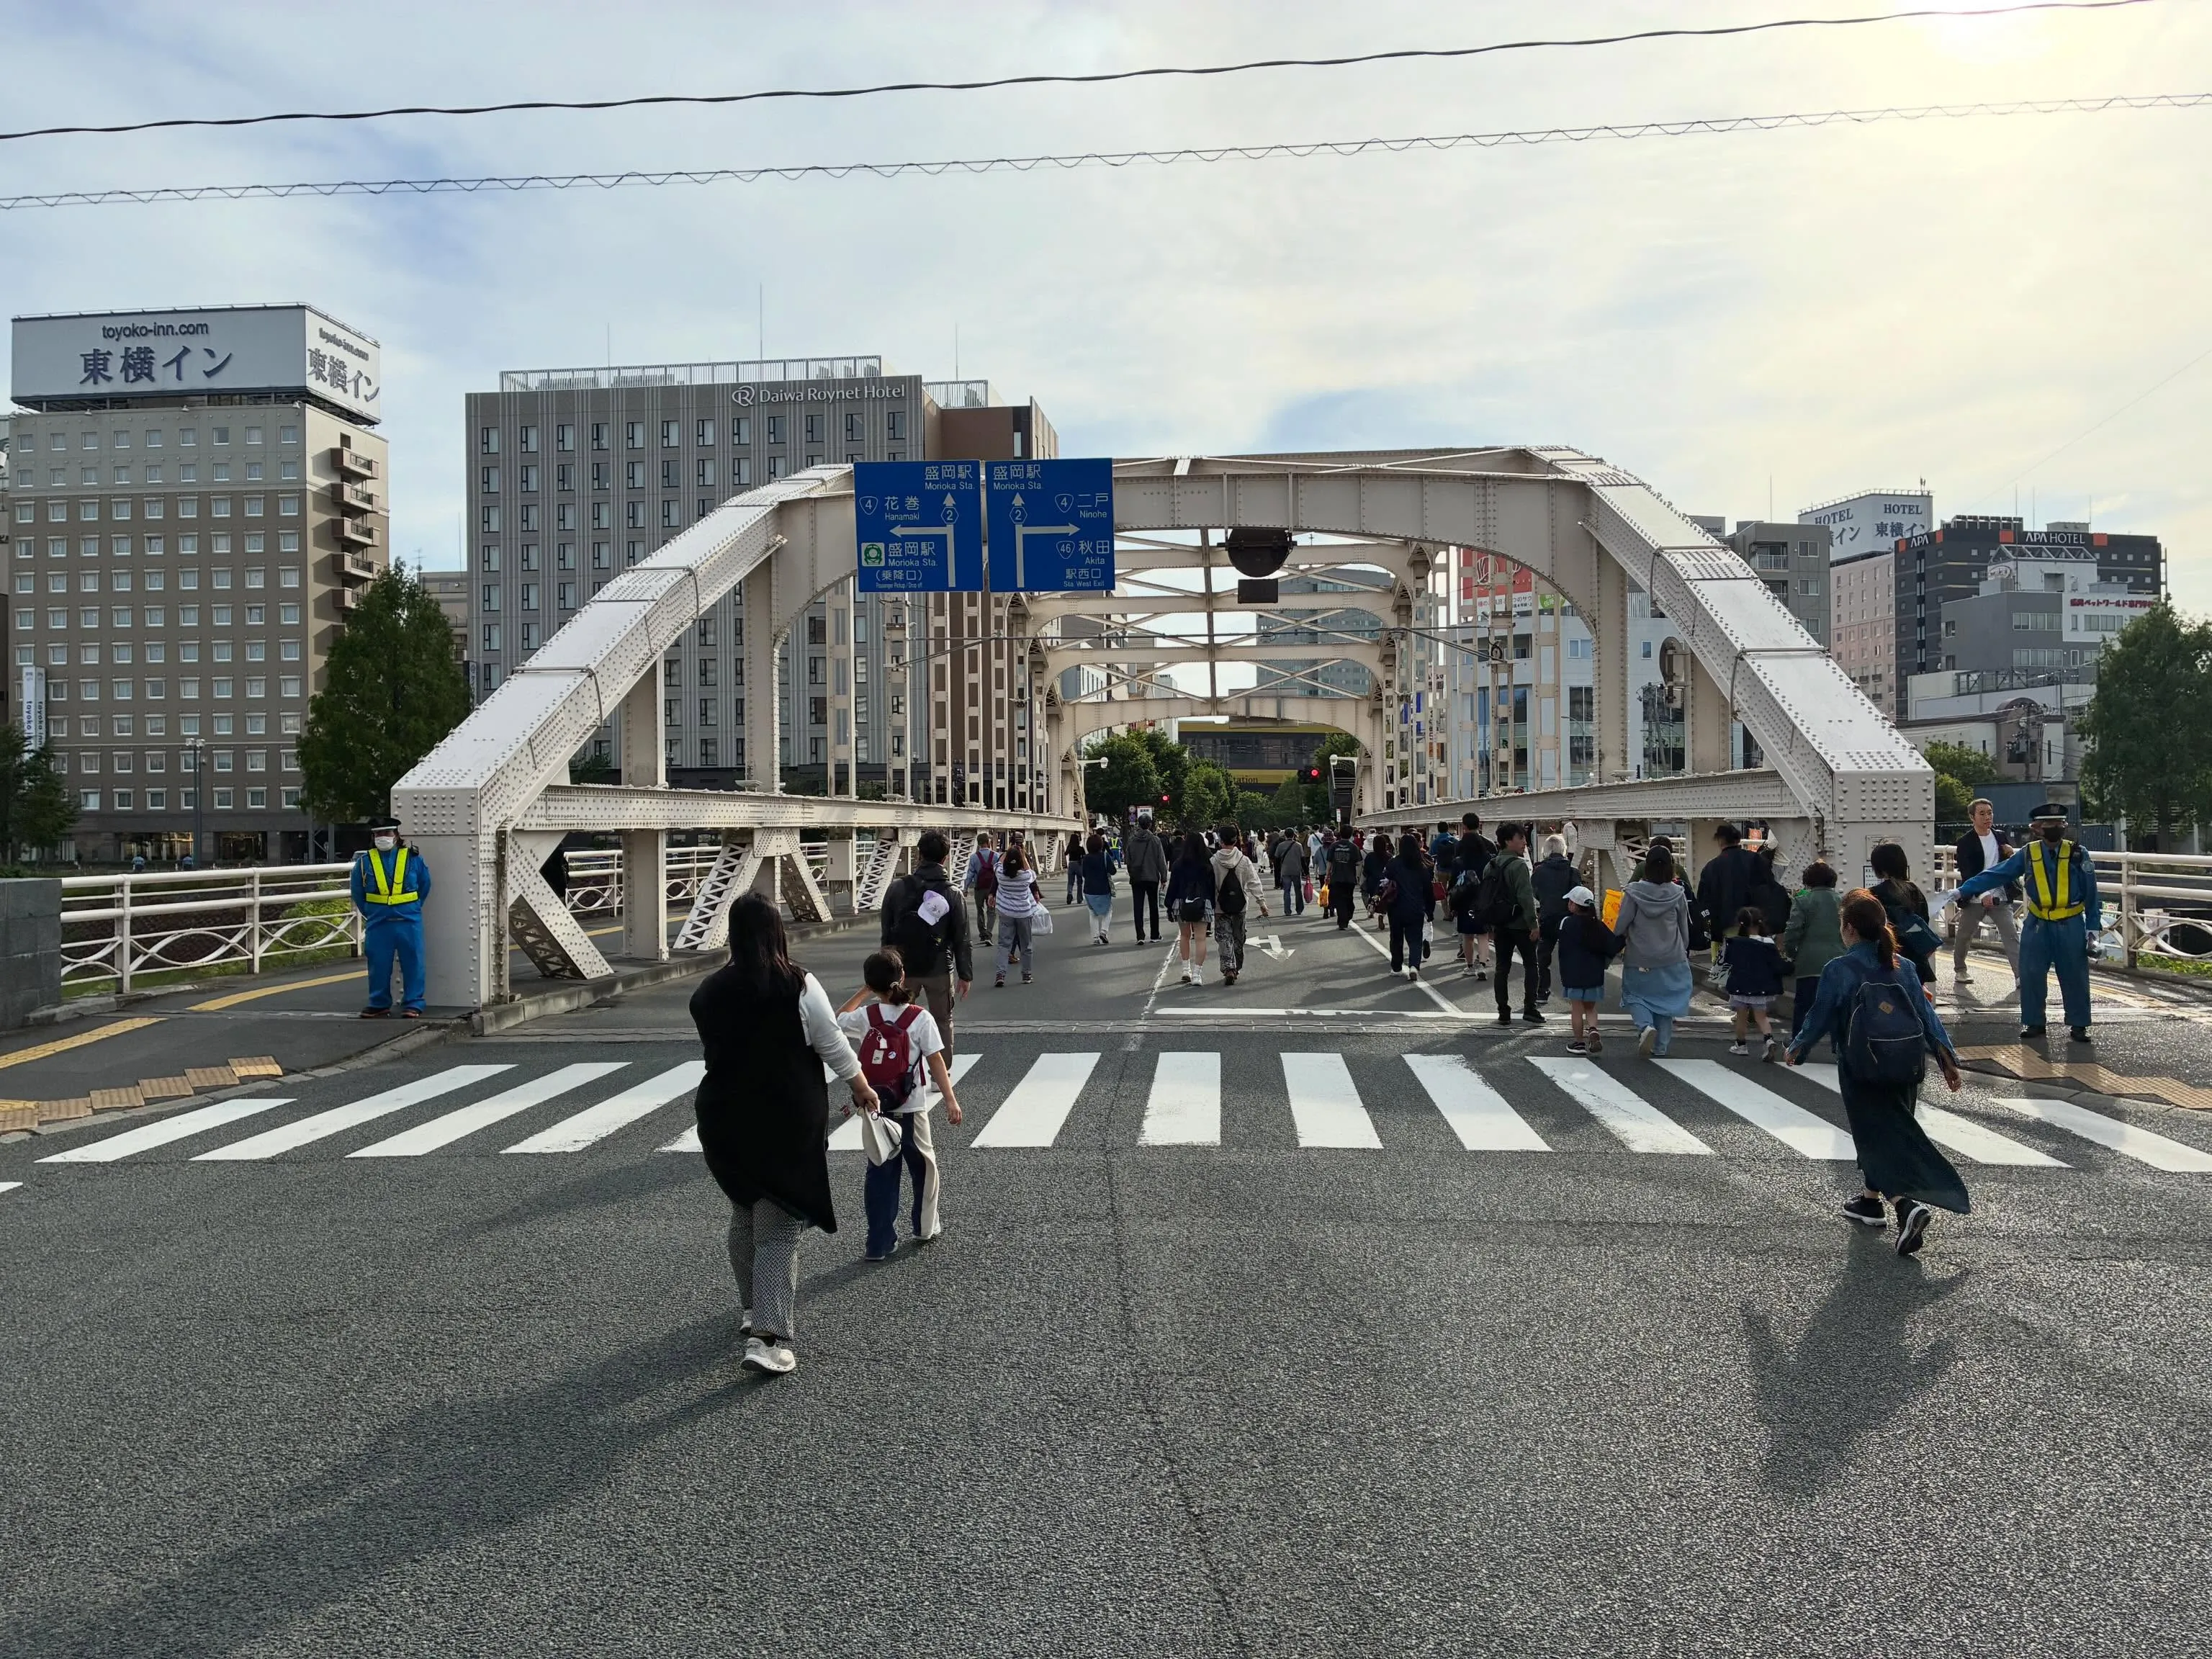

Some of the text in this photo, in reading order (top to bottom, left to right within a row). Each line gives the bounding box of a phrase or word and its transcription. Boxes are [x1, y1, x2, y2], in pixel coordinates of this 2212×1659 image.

[102, 322, 210, 341] toyoko-inn.com
[79, 346, 233, 385] 東横イン
[307, 348, 380, 402] 東横イン
[760, 385, 905, 404] Daiwa Roynet Hotel
[925, 464, 973, 480] 盛岡駅
[993, 464, 1041, 480] 盛岡駅
[925, 481, 975, 490] Morioka Sta.
[993, 482, 1025, 490] Morioka
[865, 499, 872, 510] 4
[884, 495, 920, 511] 花巻
[1060, 497, 1067, 508] 4
[1077, 493, 1109, 508] 二戸
[1079, 510, 1107, 518] Ninohe
[1884, 504, 1923, 515] HOTEL
[885, 512, 920, 521] Hanamaki
[946, 510, 953, 521] 2
[1014, 510, 1022, 521] 2
[1815, 508, 1853, 525] HOTEL
[1830, 526, 1861, 548] イン
[1910, 534, 1929, 548] APA
[2026, 532, 2086, 544] APA HOTEL
[888, 541, 936, 557] 盛岡駅
[1060, 543, 1071, 553] 46
[1079, 540, 1109, 554] 秋田
[889, 558, 938, 567] Morioka Sta.
[1084, 557, 1105, 565] Akita
[1066, 568, 1101, 579] 駅西口
[1233, 774, 1259, 784] tation
